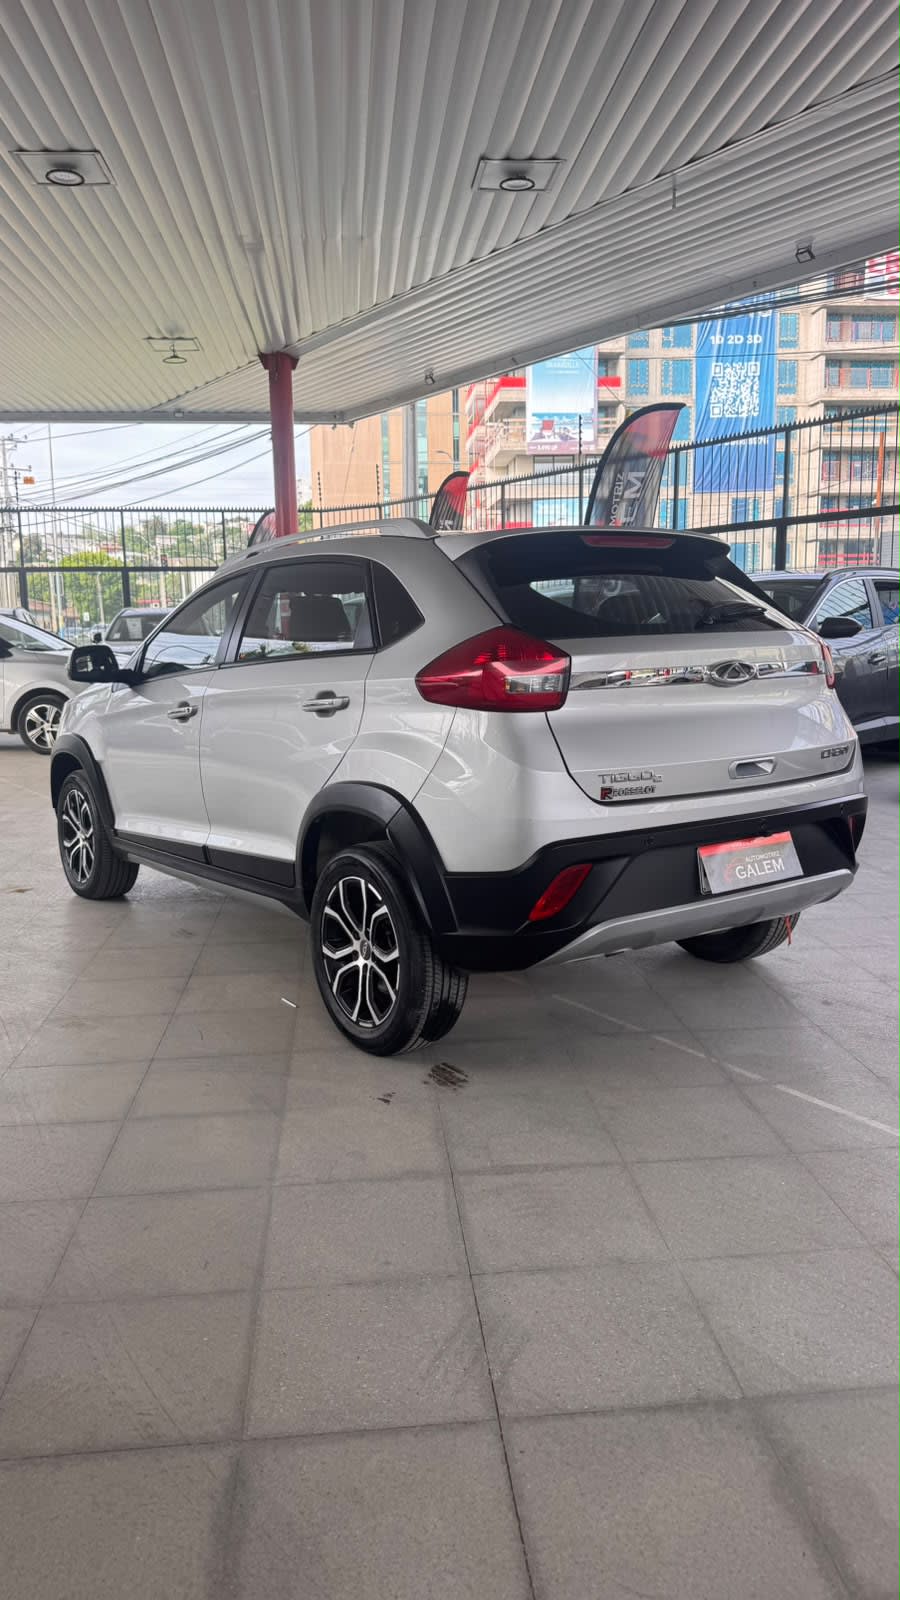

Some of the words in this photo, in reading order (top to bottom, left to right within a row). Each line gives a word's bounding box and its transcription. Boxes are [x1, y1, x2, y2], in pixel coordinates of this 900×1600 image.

[710, 335, 724, 345] 1D
[727, 335, 744, 345] 2D
[746, 334, 762, 344] 3D
[735, 858, 785, 879] GALEM
